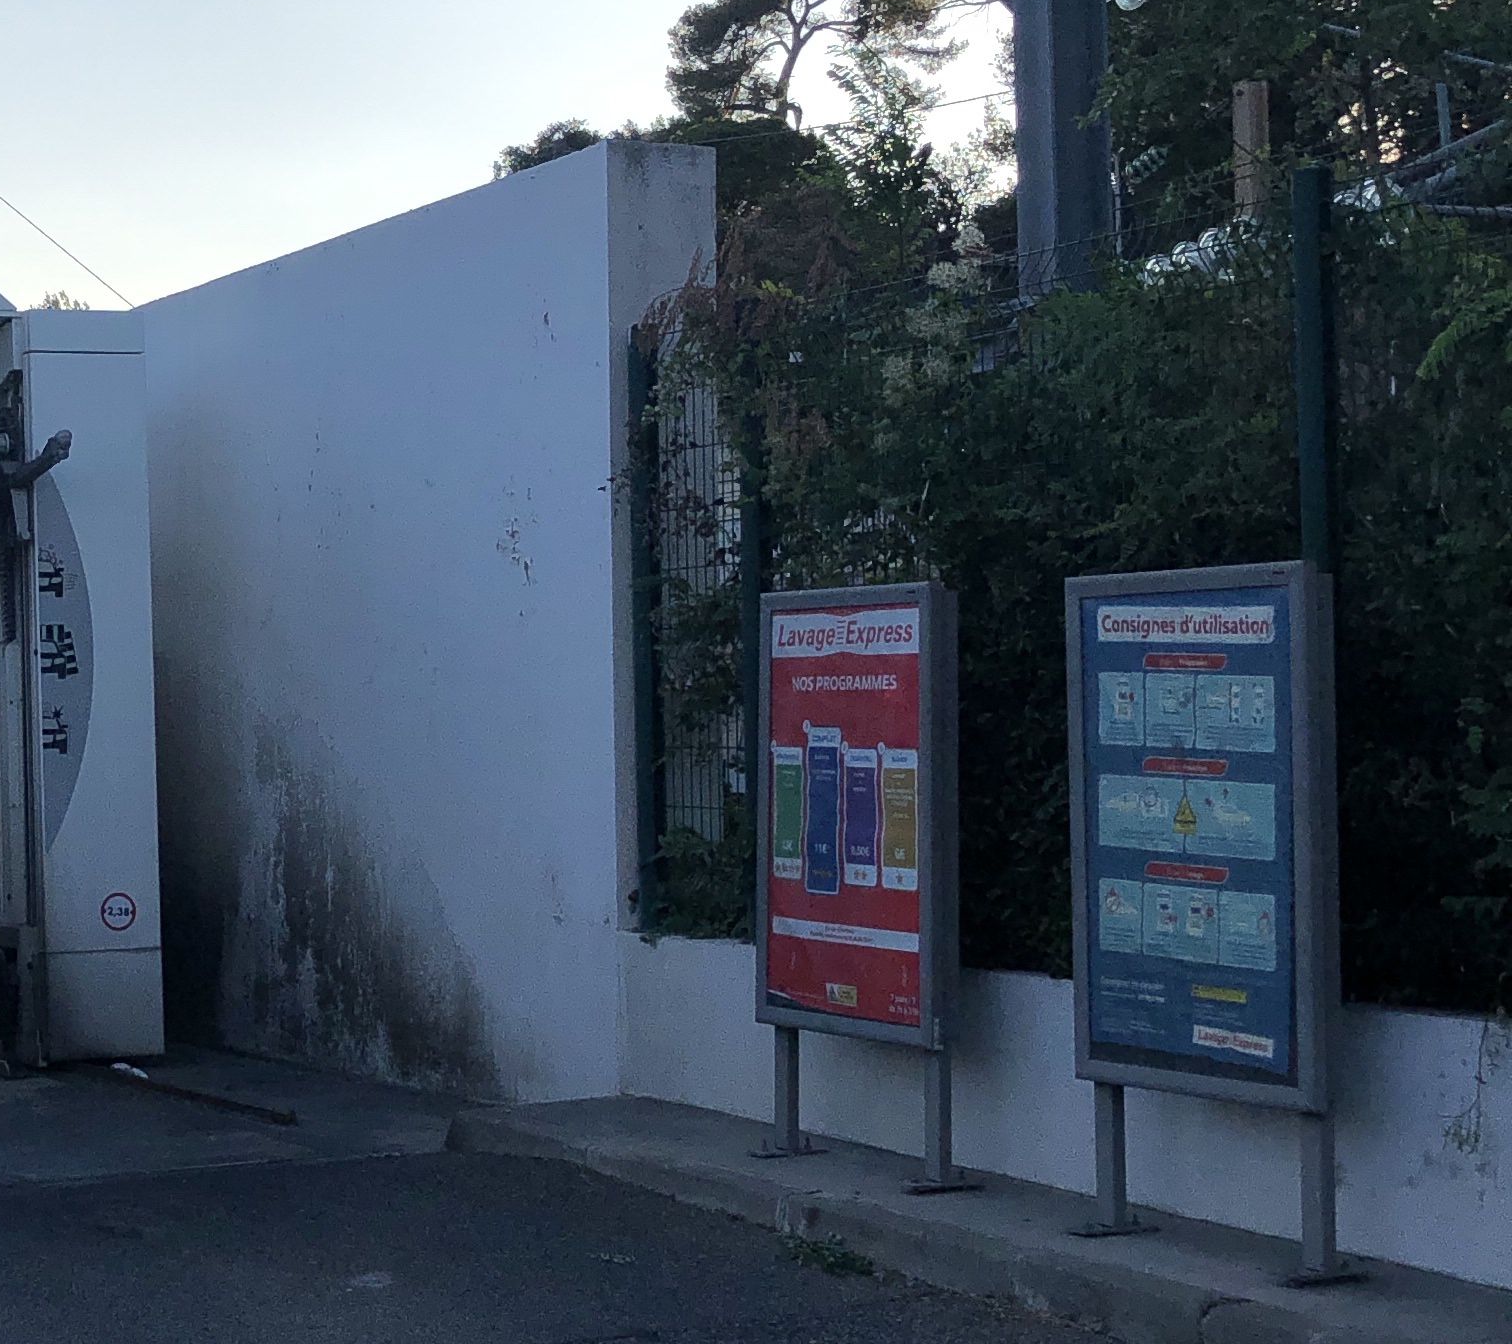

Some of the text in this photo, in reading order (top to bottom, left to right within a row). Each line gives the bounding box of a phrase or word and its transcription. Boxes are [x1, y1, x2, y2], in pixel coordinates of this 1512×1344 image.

[777, 619, 913, 651] Lavage Express
[1101, 613, 1270, 639] Consignes d'utilisation
[792, 674, 897, 692] NOS PROGRAMMES
